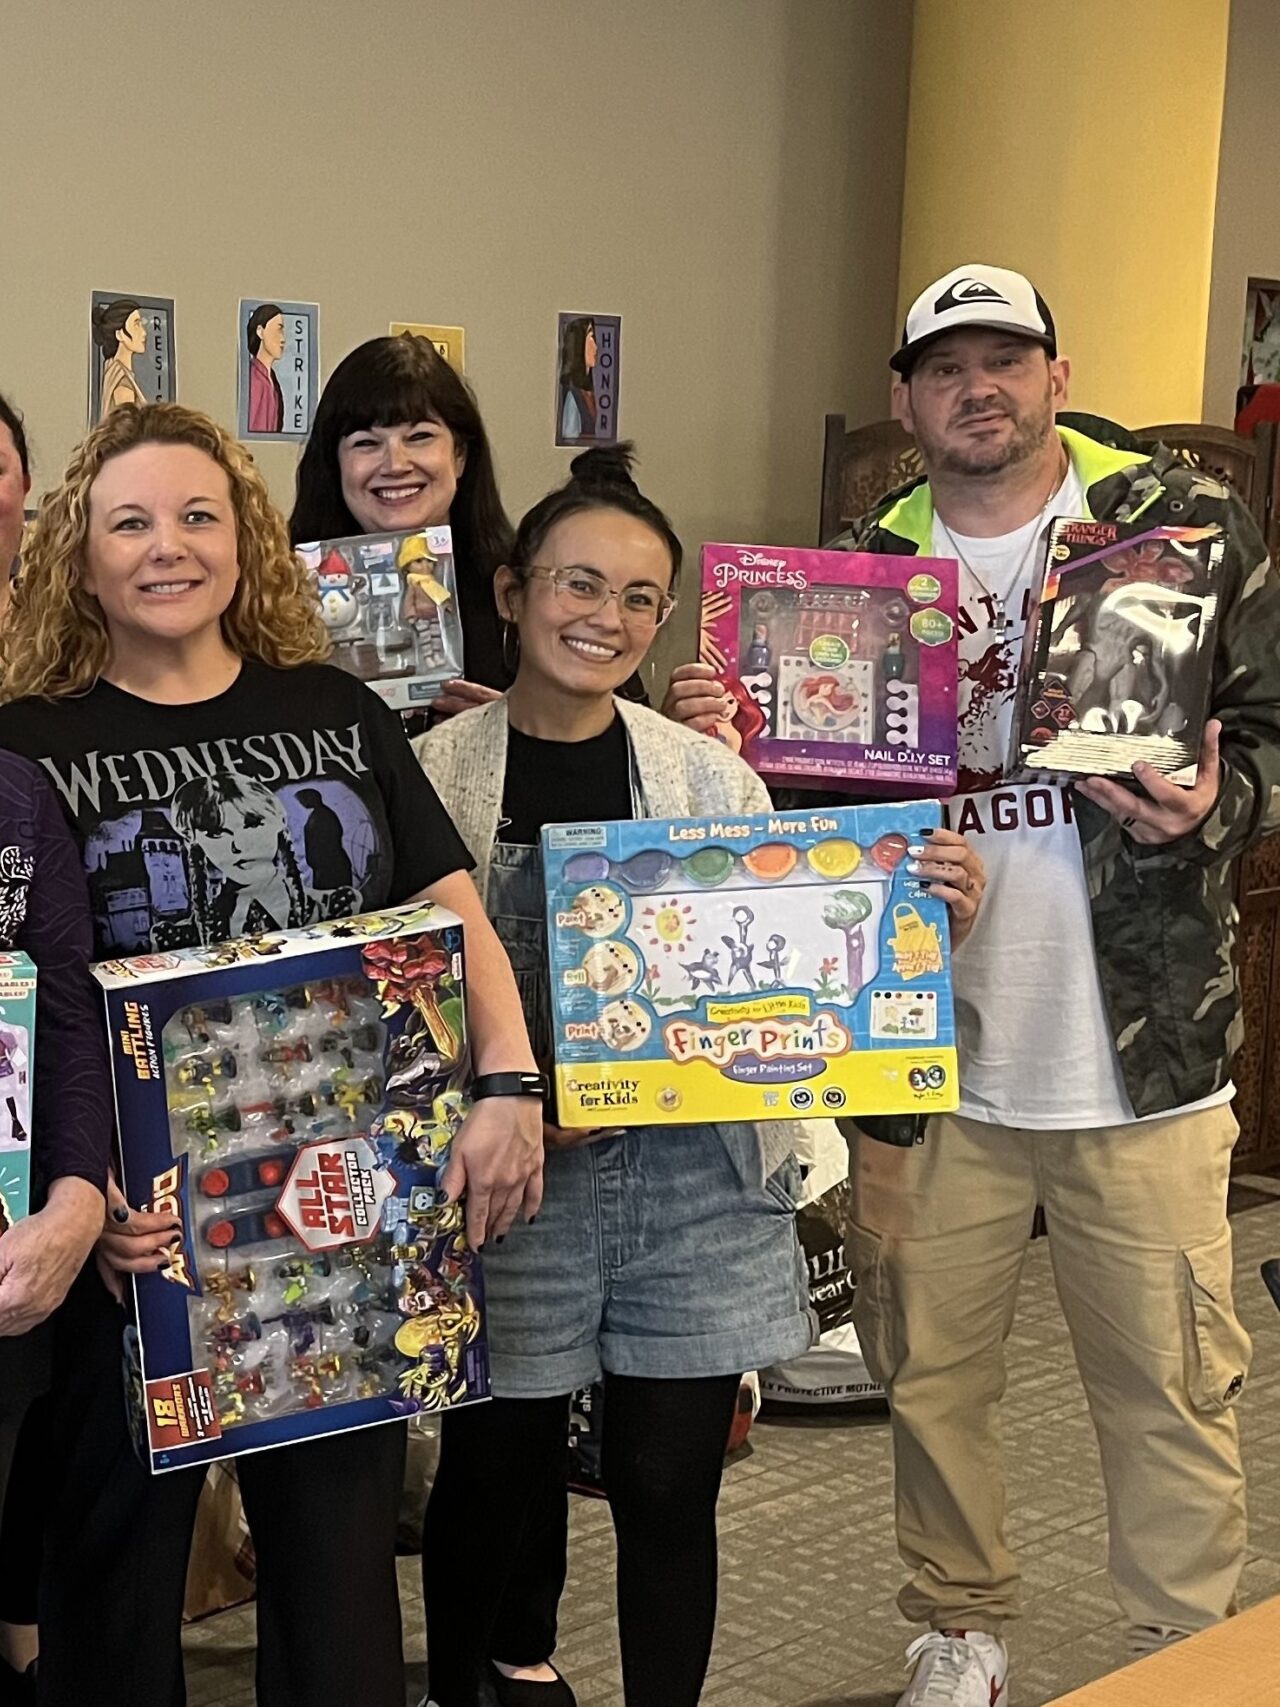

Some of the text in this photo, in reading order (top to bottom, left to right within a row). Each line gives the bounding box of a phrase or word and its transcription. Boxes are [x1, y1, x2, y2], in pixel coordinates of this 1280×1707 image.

[293, 320, 304, 428] STRIKE
[598, 332, 613, 430] HONOR
[737, 550, 787, 571] Disney
[38, 723, 371, 818] WEDNESDAY
[864, 749, 894, 762] NAIL
[928, 754, 951, 766] SET
[669, 825, 706, 841] Less
[710, 823, 751, 838] Mess
[768, 819, 807, 834] More
[120, 1030, 133, 1055] MINI
[124, 1002, 151, 1080] BATTLING
[673, 1027, 752, 1058] Finger
[732, 1062, 813, 1076] Finger Painting Set
[566, 1079, 641, 1092] Creativity
[580, 1092, 639, 1107] for Kids
[295, 1170, 327, 1228] ALL
[317, 1153, 355, 1237] STAR
[345, 1151, 369, 1227] COLLECTOR
[360, 1169, 376, 1205] PACK
[153, 1165, 191, 1287] AKDO
[777, 1384, 843, 1396] PROTECTIVE
[152, 1399, 178, 1427] 18
